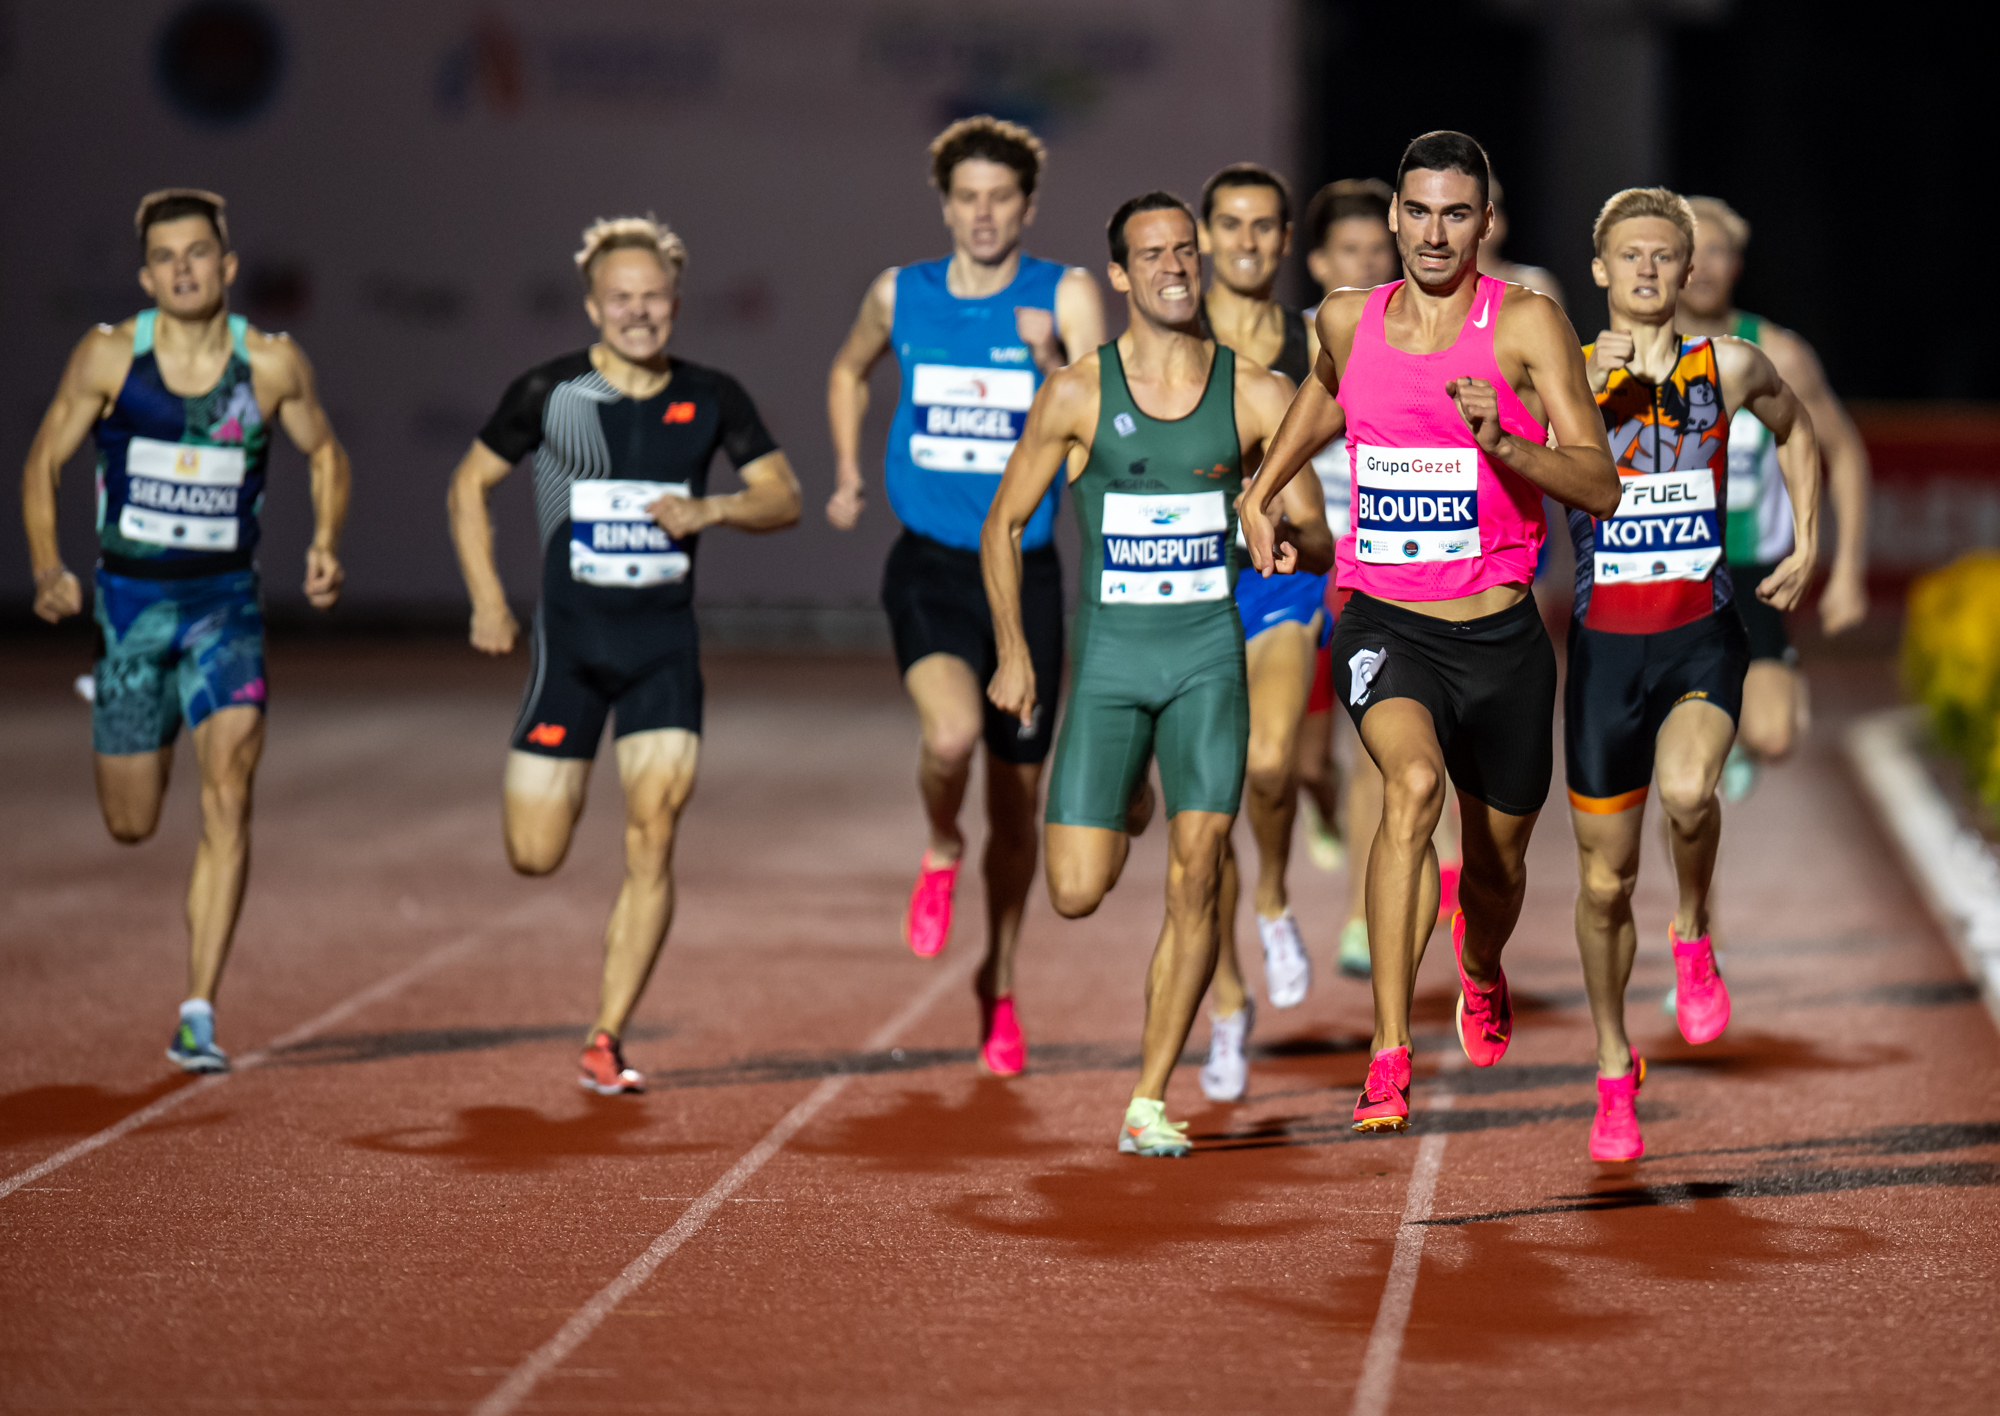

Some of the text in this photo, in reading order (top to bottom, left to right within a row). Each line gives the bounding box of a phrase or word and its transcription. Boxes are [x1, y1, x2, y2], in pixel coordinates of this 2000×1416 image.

[926, 406, 1016, 438] BUIGEL
[128, 477, 238, 515] SIERADZKI
[1359, 492, 1473, 522] BLOUDEK
[1633, 482, 1697, 505] FUEL
[1602, 515, 1711, 546] KOTYZA
[1107, 534, 1219, 565] VANDEPUTTE
